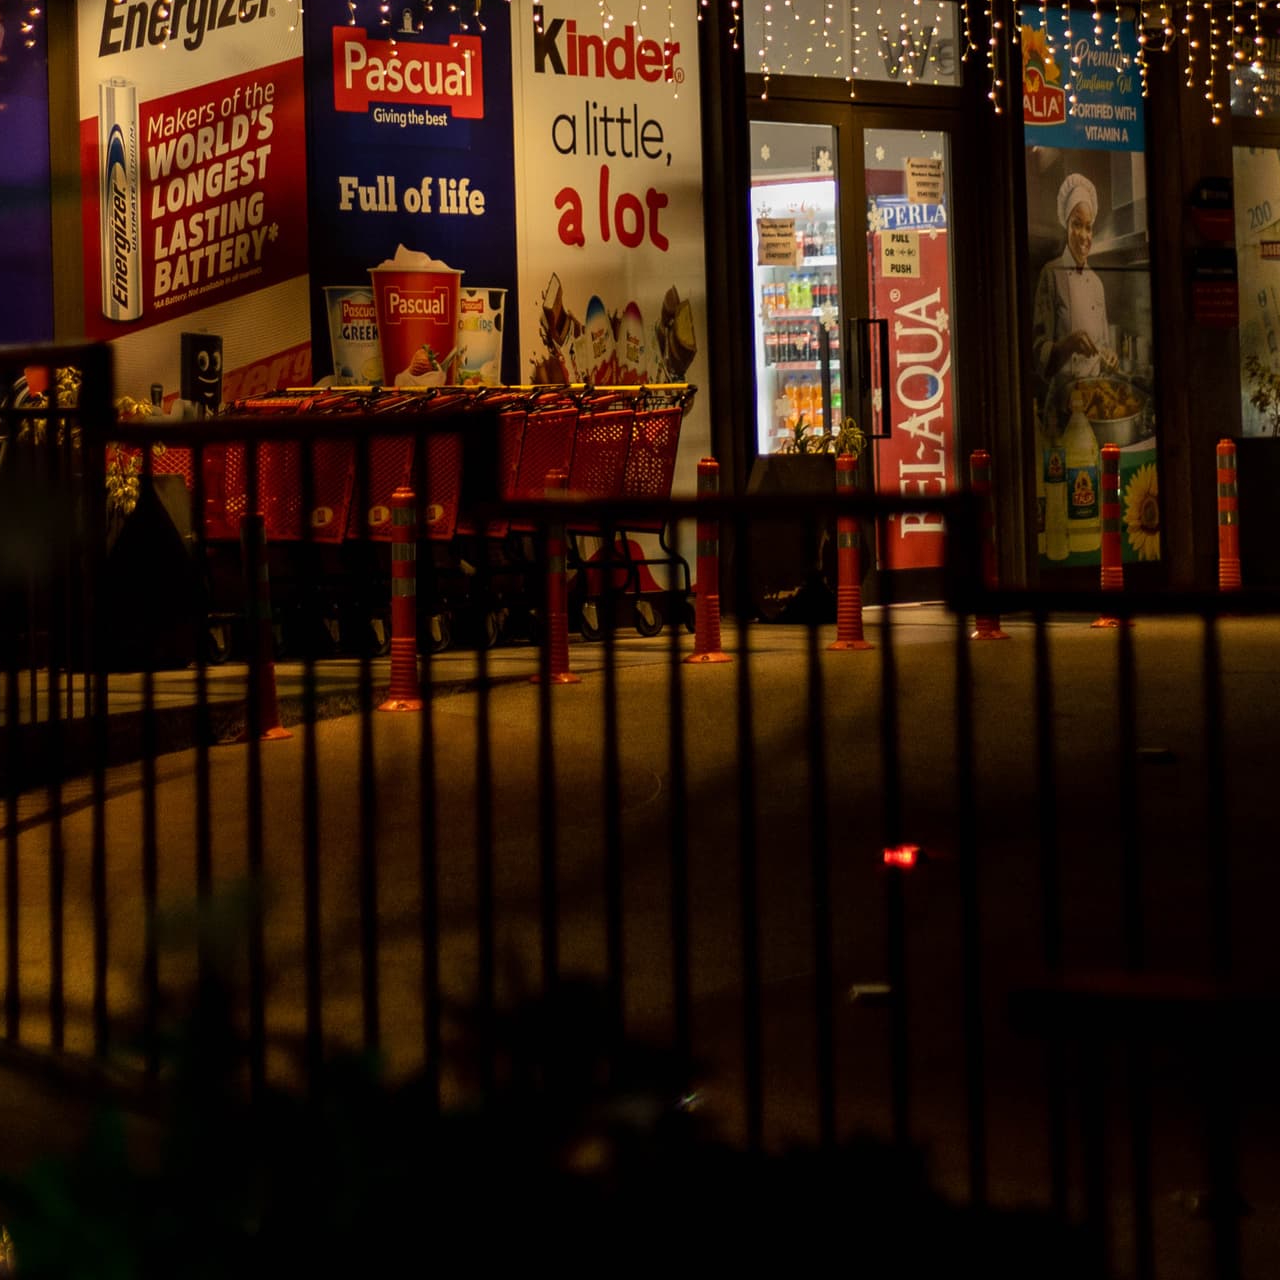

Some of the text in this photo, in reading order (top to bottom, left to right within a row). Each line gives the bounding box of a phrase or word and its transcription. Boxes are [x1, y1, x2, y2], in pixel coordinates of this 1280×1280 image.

[343, 40, 474, 97] Pascual
[146, 82, 275, 143] Makers of the
[373, 107, 448, 128] Giving the best
[552, 100, 672, 167] a little,
[1073, 103, 1137, 121] FORTIFIED WITH
[1084, 125, 1129, 143] VITAMIN A
[147, 103, 274, 182] WORLD'S
[150, 143, 272, 221] LONGEST
[338, 175, 487, 216] Full of life
[153, 191, 265, 262] LASTING
[554, 164, 669, 252] a lot
[111, 183, 132, 309] Energizer
[891, 233, 910, 243] PULL
[890, 263, 912, 274] PUSH
[343, 302, 377, 318] Pascua
[389, 292, 445, 315] Pascual
